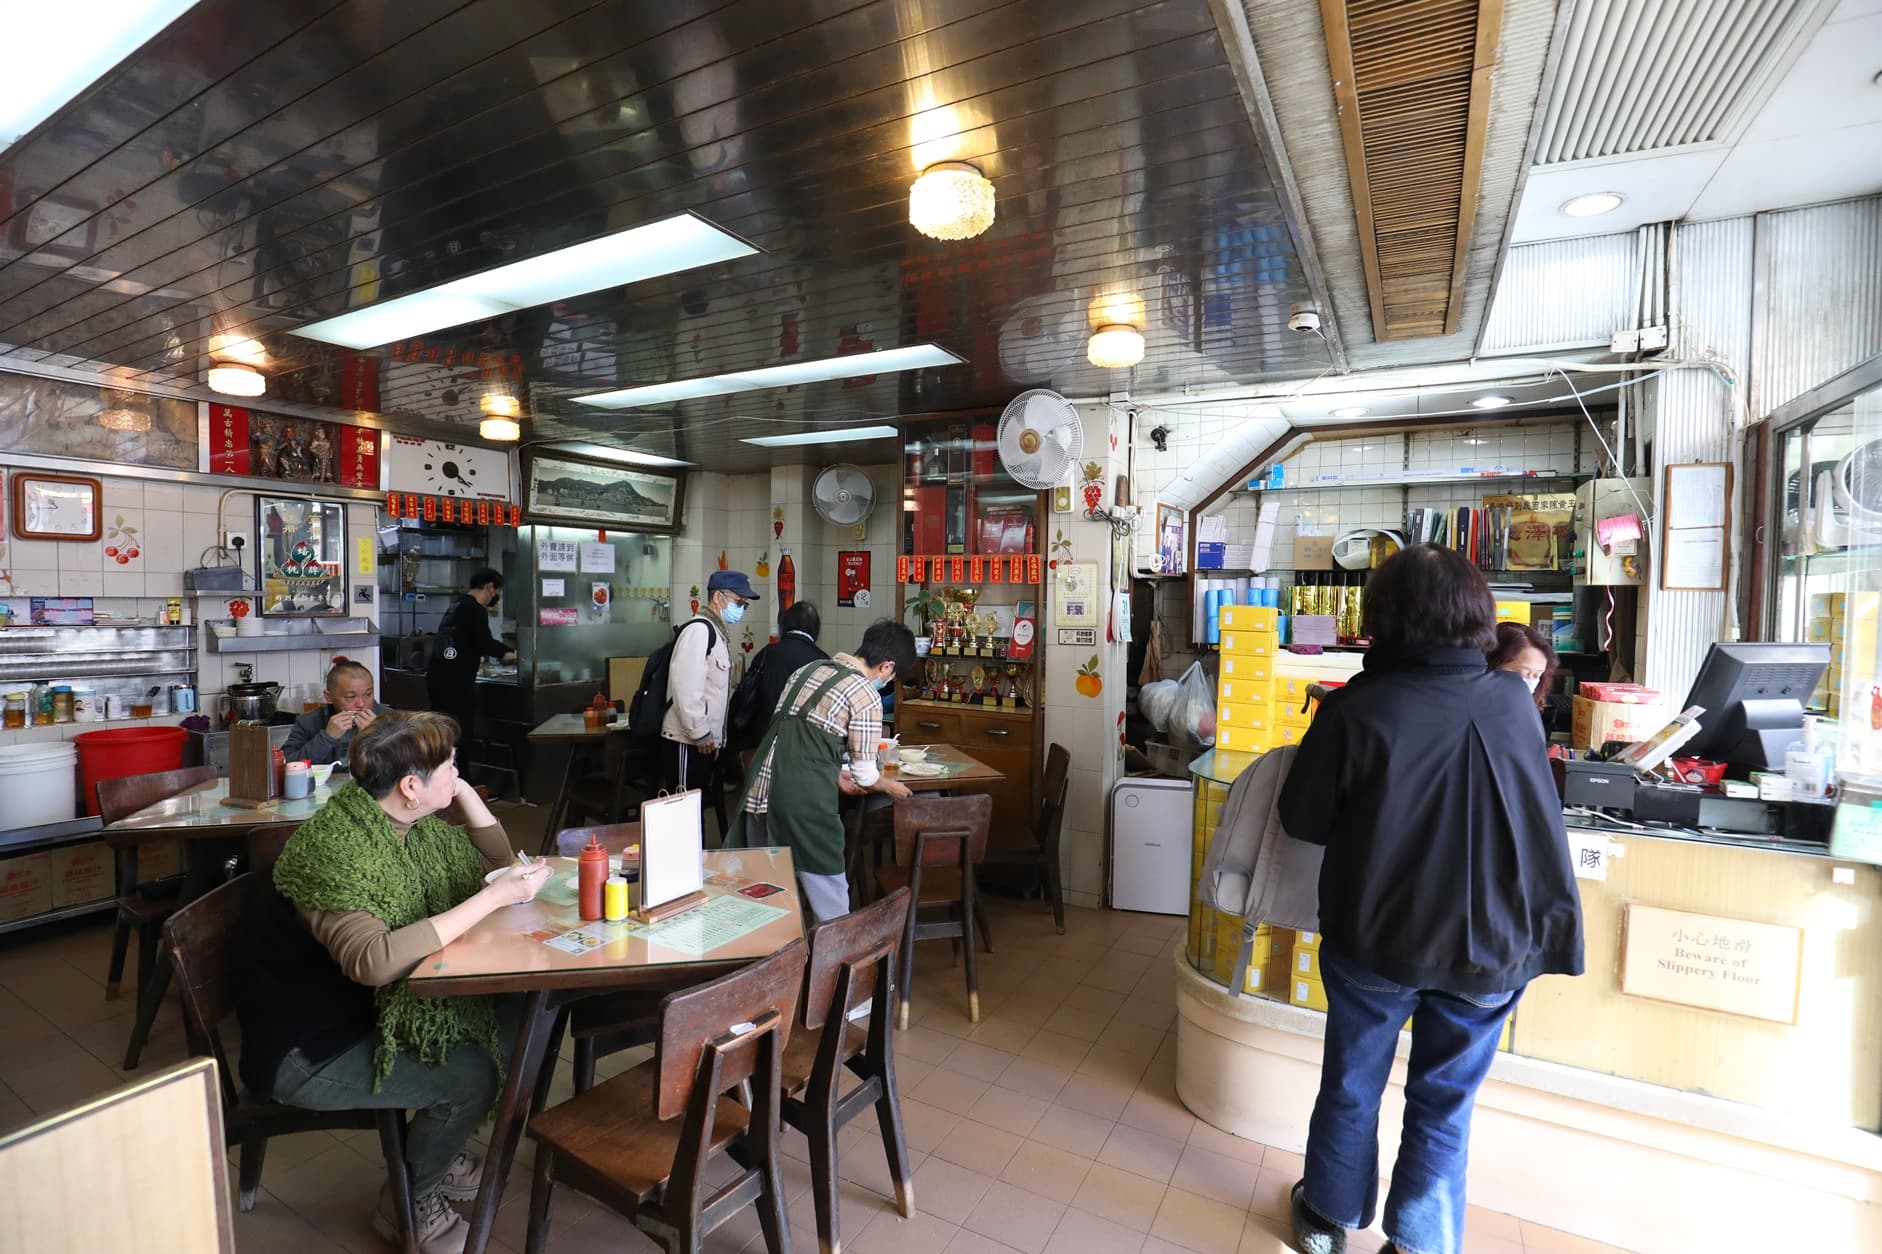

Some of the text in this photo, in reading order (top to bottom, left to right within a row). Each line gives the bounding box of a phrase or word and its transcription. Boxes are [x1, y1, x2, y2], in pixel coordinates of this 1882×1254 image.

[1580, 848, 1602, 868] 隊
[1672, 928, 1752, 953] 小心地滑
[1675, 947, 1749, 968] Beware of
[1657, 959, 1762, 985] Slippery Floor
